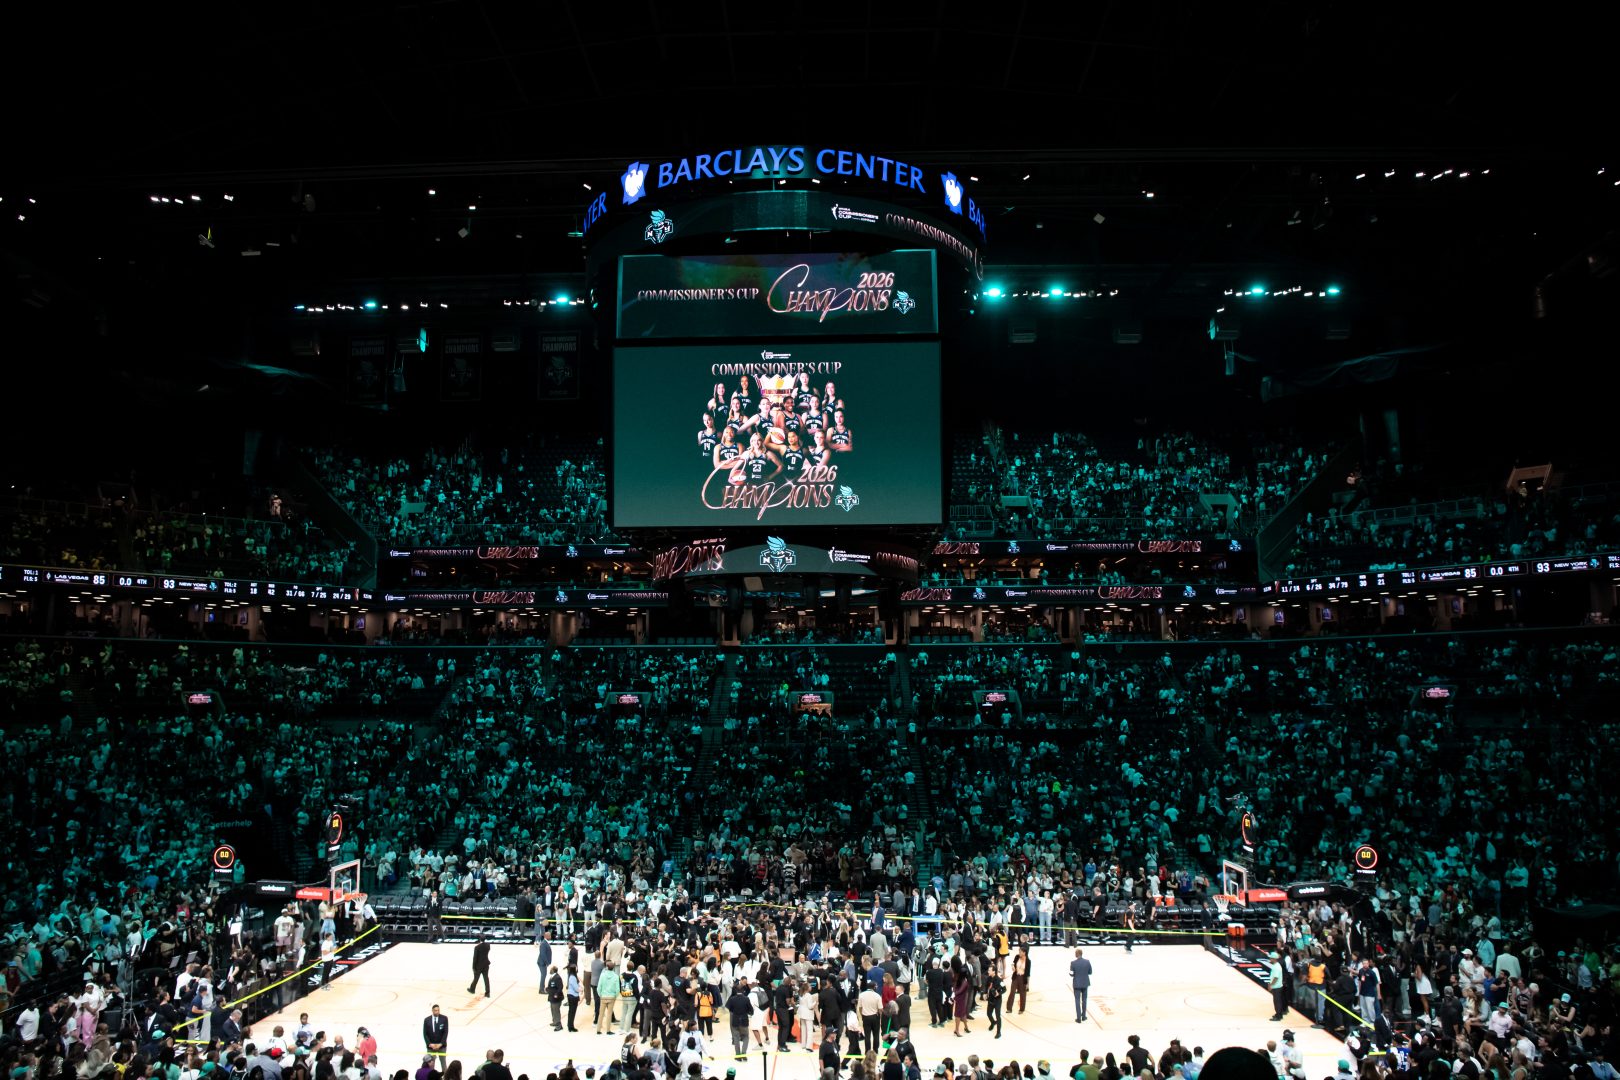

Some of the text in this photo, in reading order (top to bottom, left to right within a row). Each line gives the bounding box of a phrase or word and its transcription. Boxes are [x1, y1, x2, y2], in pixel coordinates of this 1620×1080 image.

[657, 147, 926, 193] BARCLAYS CENTER
[885, 213, 962, 253] COMMISSIONER'S
[857, 272, 895, 289] 2026
[638, 288, 760, 301] COMMISSIONER'S CUP
[767, 263, 892, 323] CHAMPIONS
[711, 362, 842, 376] COMMISSIONER'S CUP
[797, 465, 838, 482] 2026
[702, 455, 834, 521] CHAMPIONS
[1464, 568, 1477, 578] 85
[1490, 567, 1503, 576] 0.0
[1537, 562, 1550, 573] 93
[93, 575, 106, 585] 85
[119, 577, 132, 586] 0.0
[163, 580, 176, 589] 93
